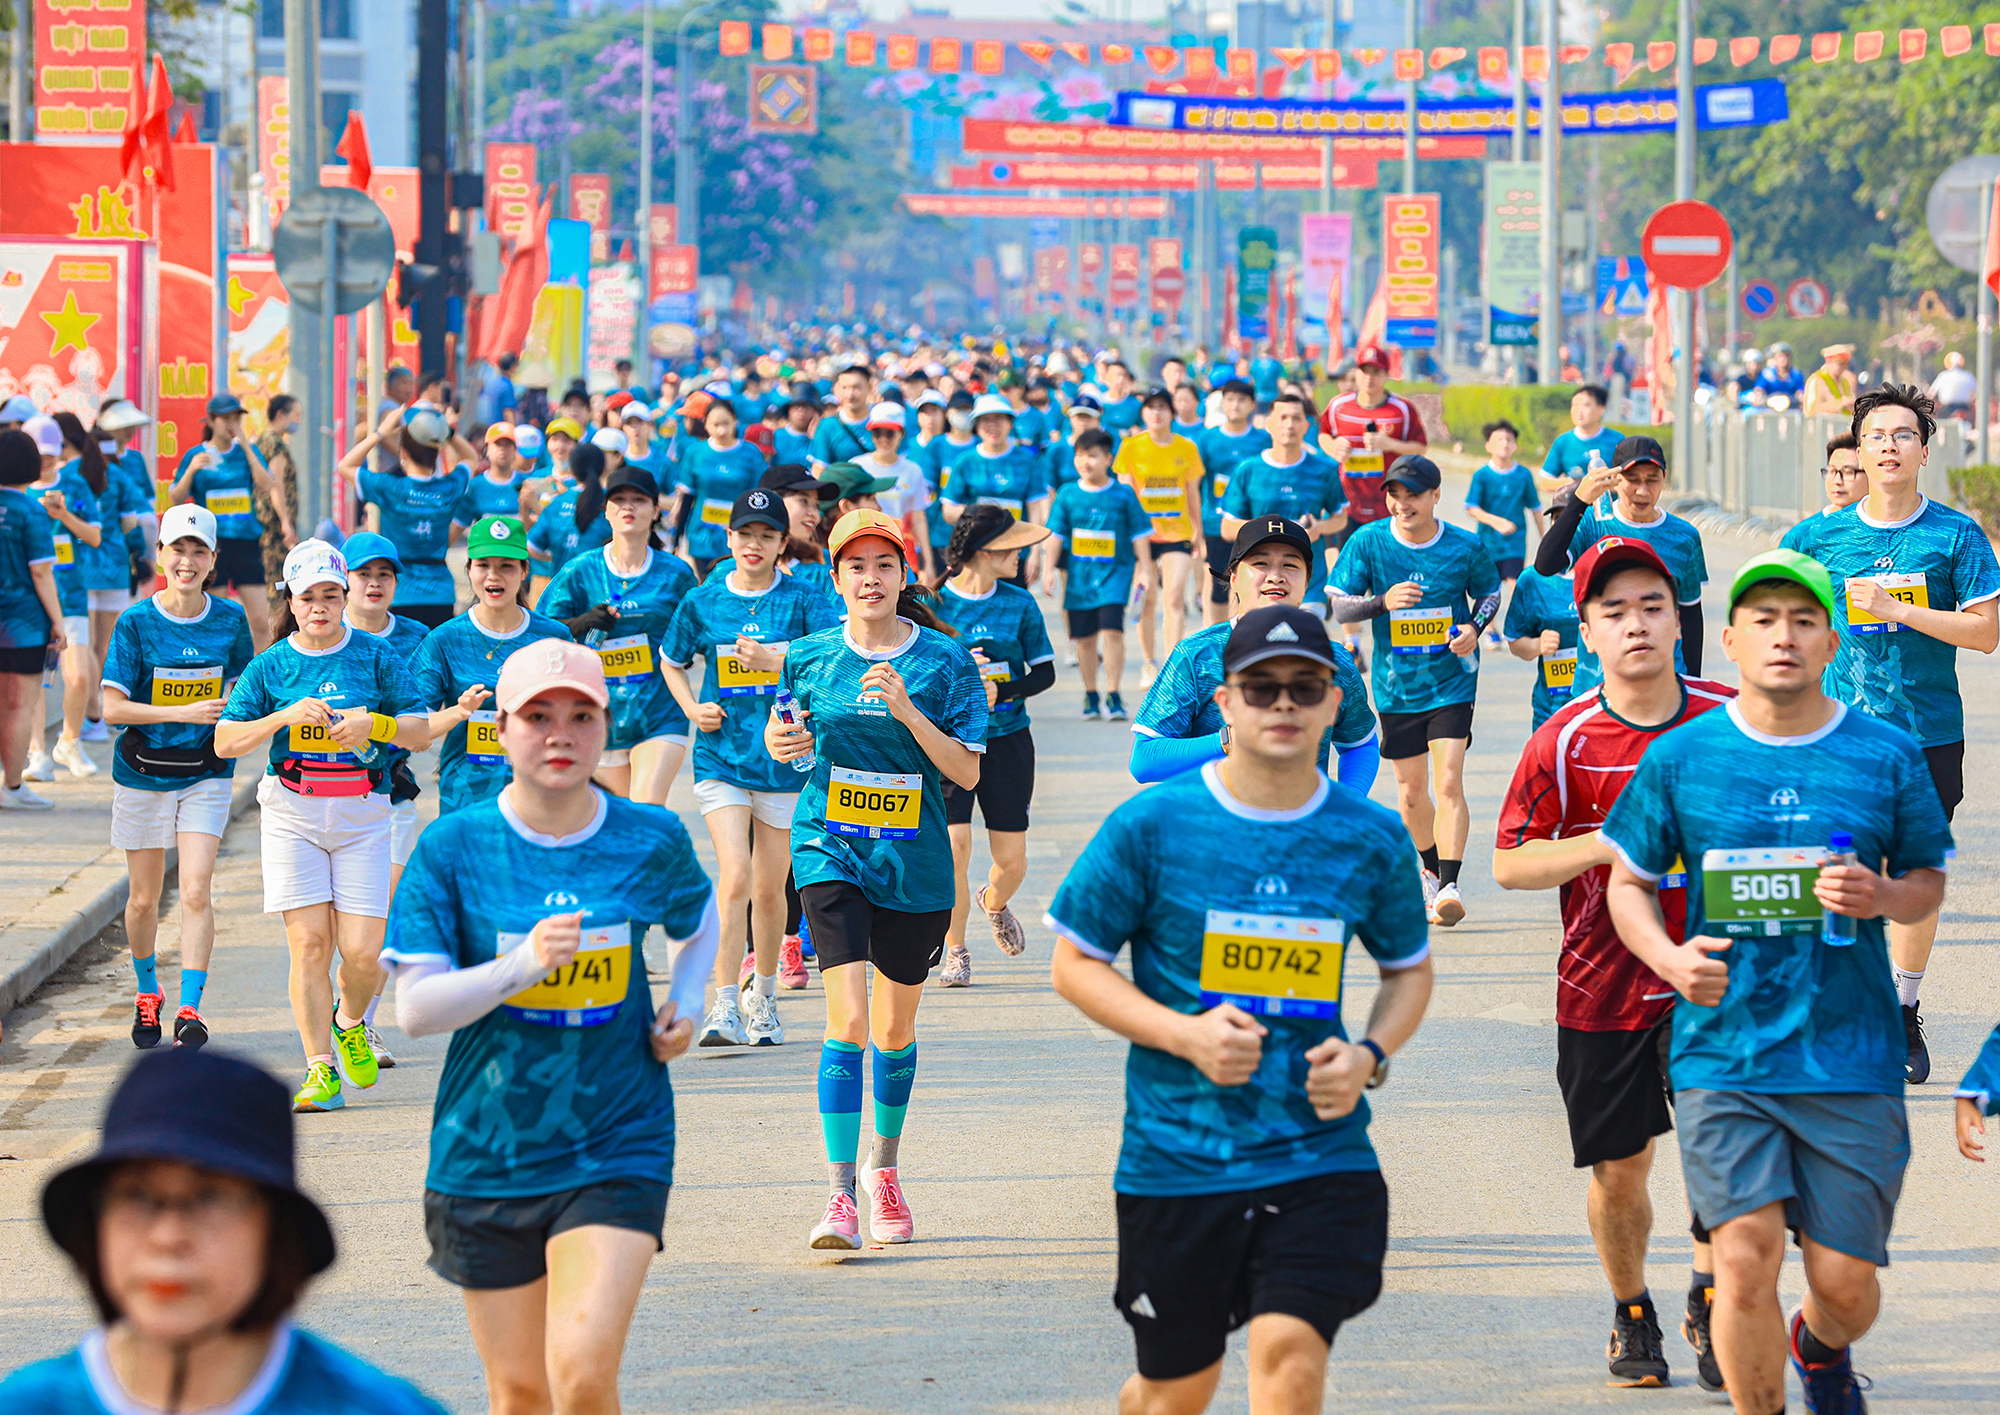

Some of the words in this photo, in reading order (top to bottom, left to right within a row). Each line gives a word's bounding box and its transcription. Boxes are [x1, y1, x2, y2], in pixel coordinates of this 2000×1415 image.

[160, 356, 207, 398] NĂM
[1267, 520, 1285, 534] H
[1400, 622, 1444, 636] 81002
[600, 650, 641, 667] 0991
[162, 682, 213, 697] 80726
[840, 788, 909, 813] 80067
[1731, 873, 1801, 901] 5061
[1223, 942, 1322, 975] 80742
